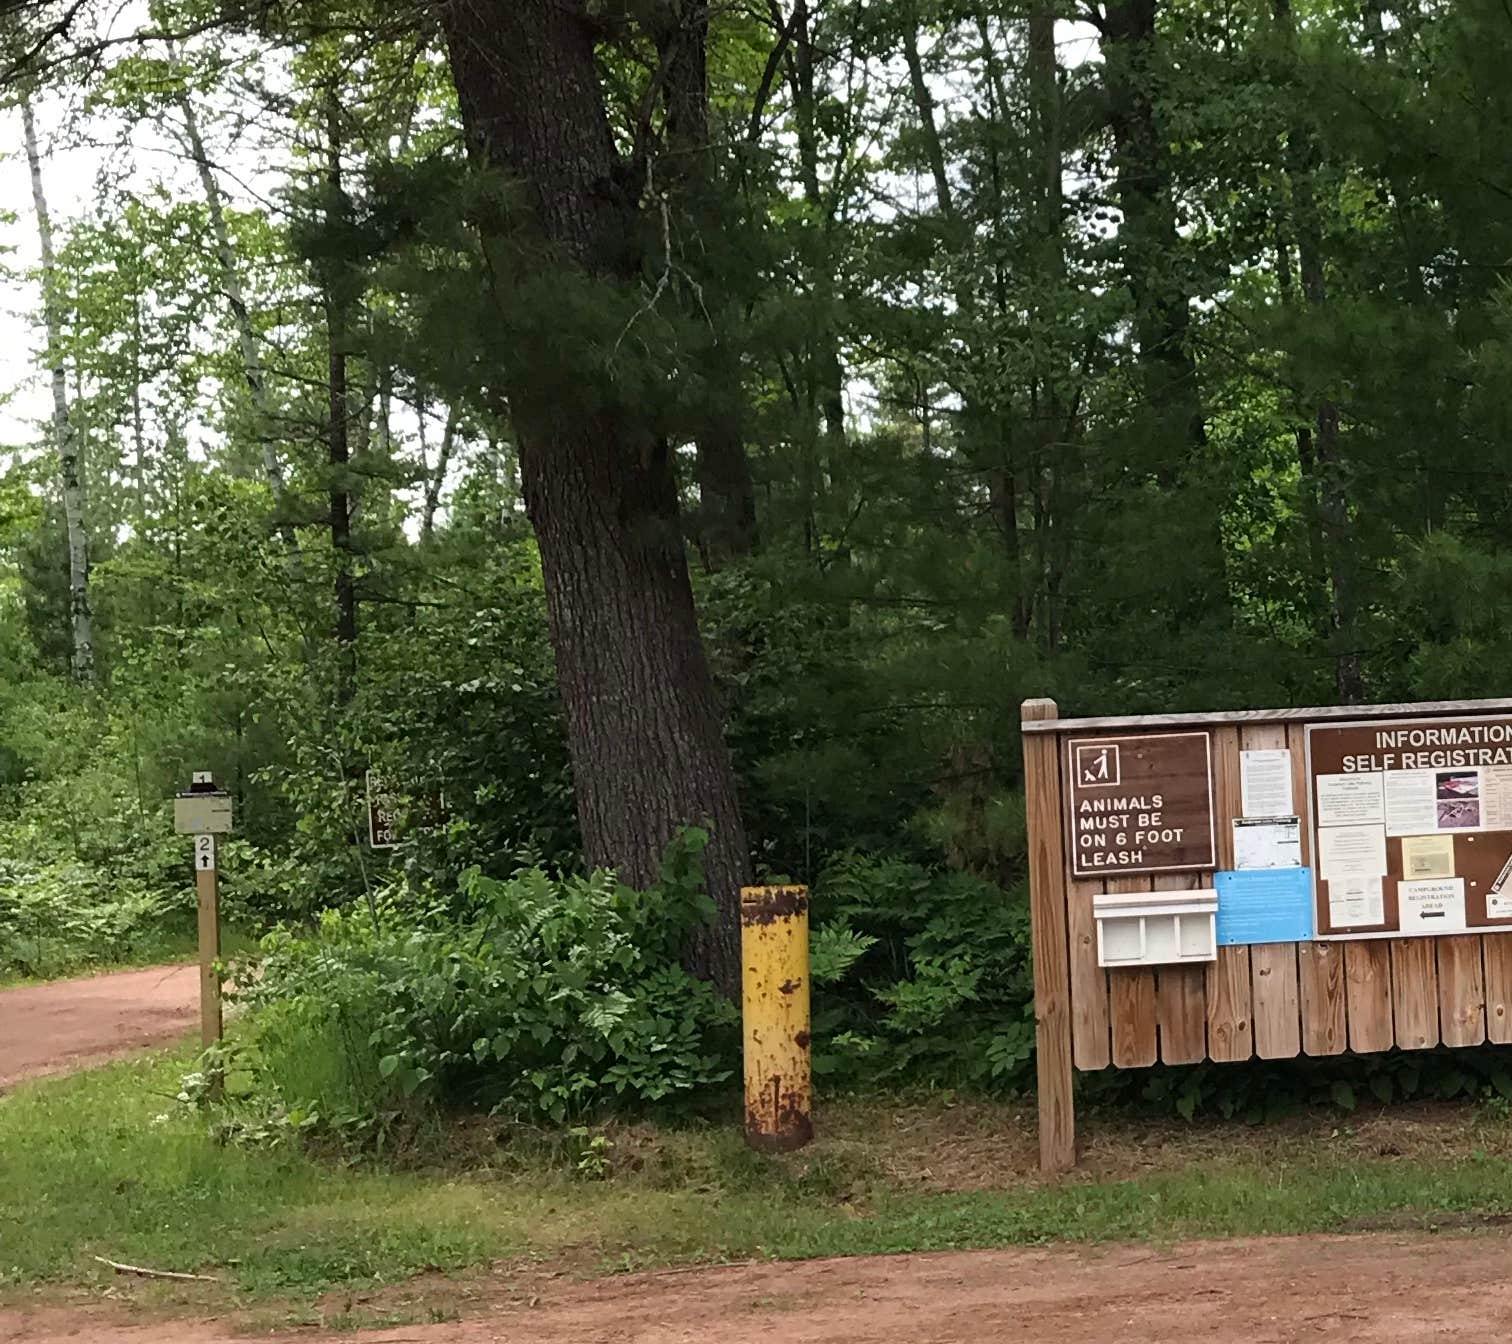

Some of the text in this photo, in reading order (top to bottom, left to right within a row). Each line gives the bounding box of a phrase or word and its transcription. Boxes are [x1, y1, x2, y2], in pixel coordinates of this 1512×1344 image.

[1342, 754, 1395, 773] SELF
[1080, 794, 1163, 813] ANIMALS
[1080, 812, 1162, 831] MUST BE
[200, 837, 210, 851] 2
[1080, 828, 1184, 847] ON 6 FOOT
[1081, 850, 1143, 867] LEASH
